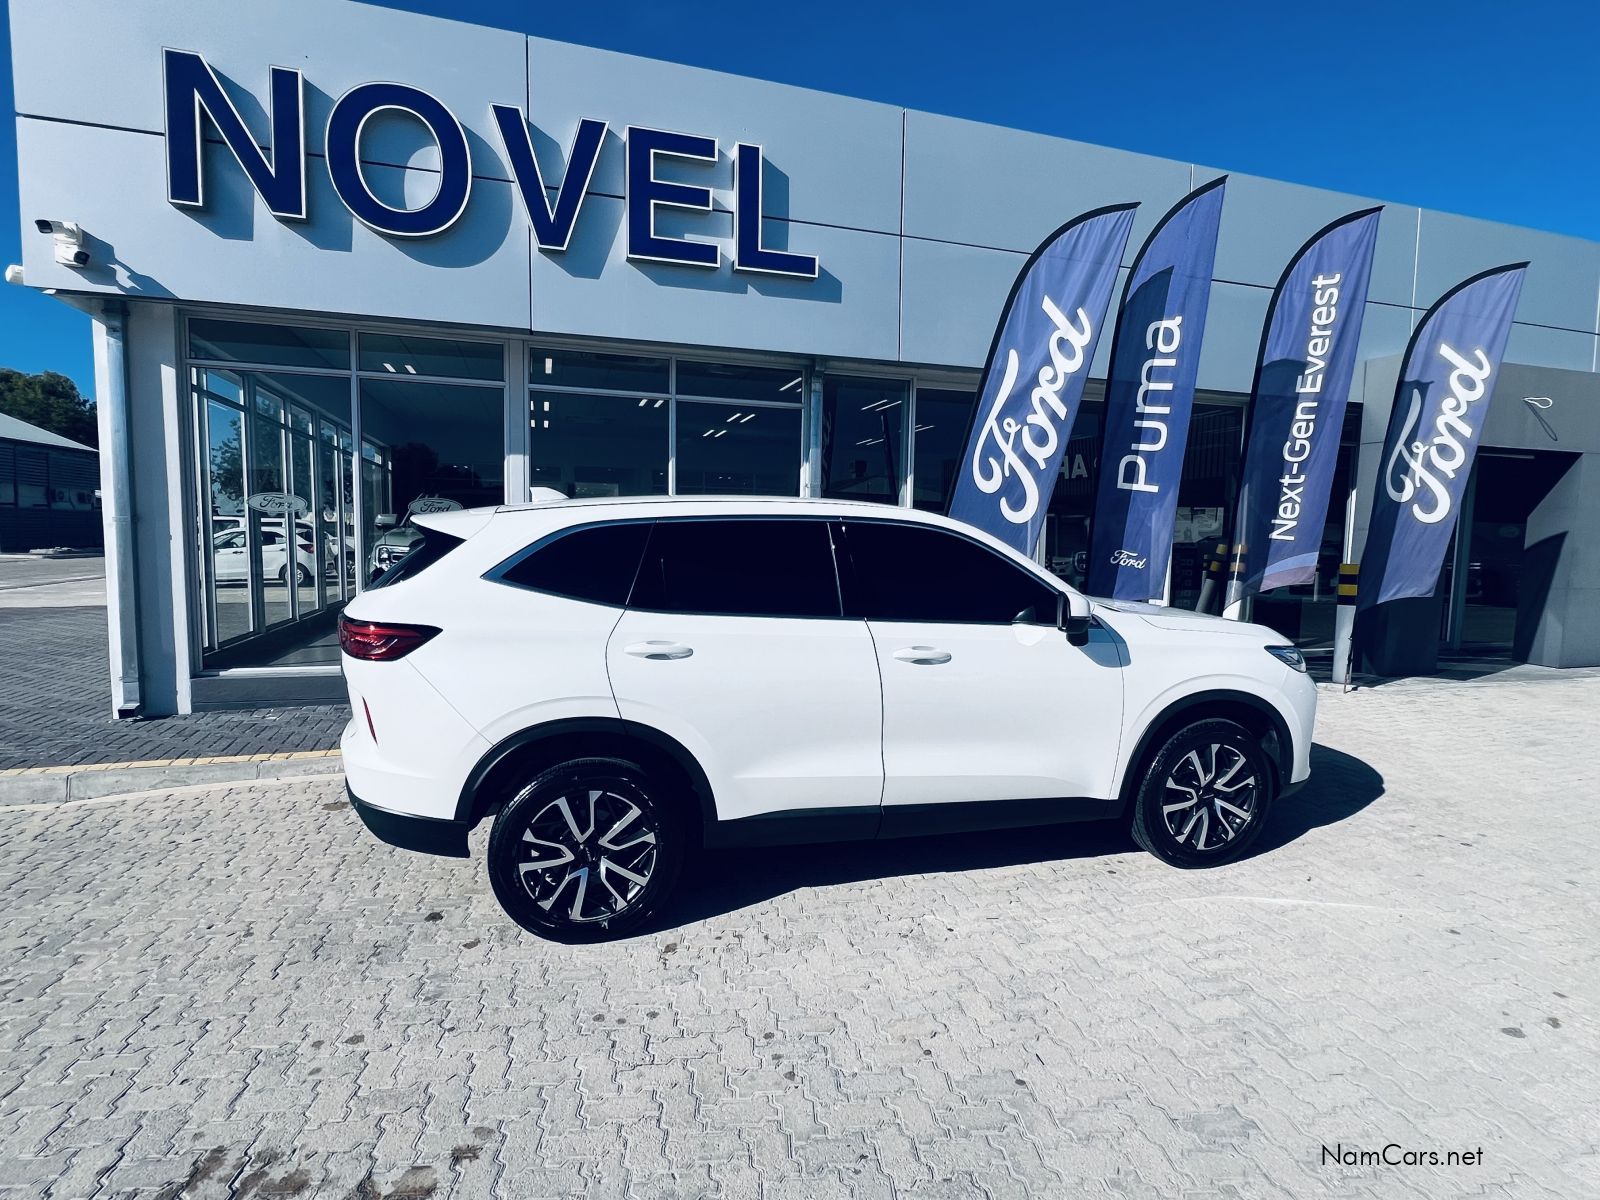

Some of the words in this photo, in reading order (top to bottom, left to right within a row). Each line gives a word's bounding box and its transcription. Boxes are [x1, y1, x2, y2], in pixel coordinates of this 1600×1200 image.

[162, 46, 820, 280] NOVEL
[972, 294, 1092, 524] Ford
[1116, 315, 1183, 493] Puma
[1268, 401, 1318, 541] Next-Gen
[1295, 273, 1341, 393] Everest
[1385, 343, 1491, 524] Ford
[420, 500, 452, 513] Ford
[1110, 549, 1147, 570] Ford
